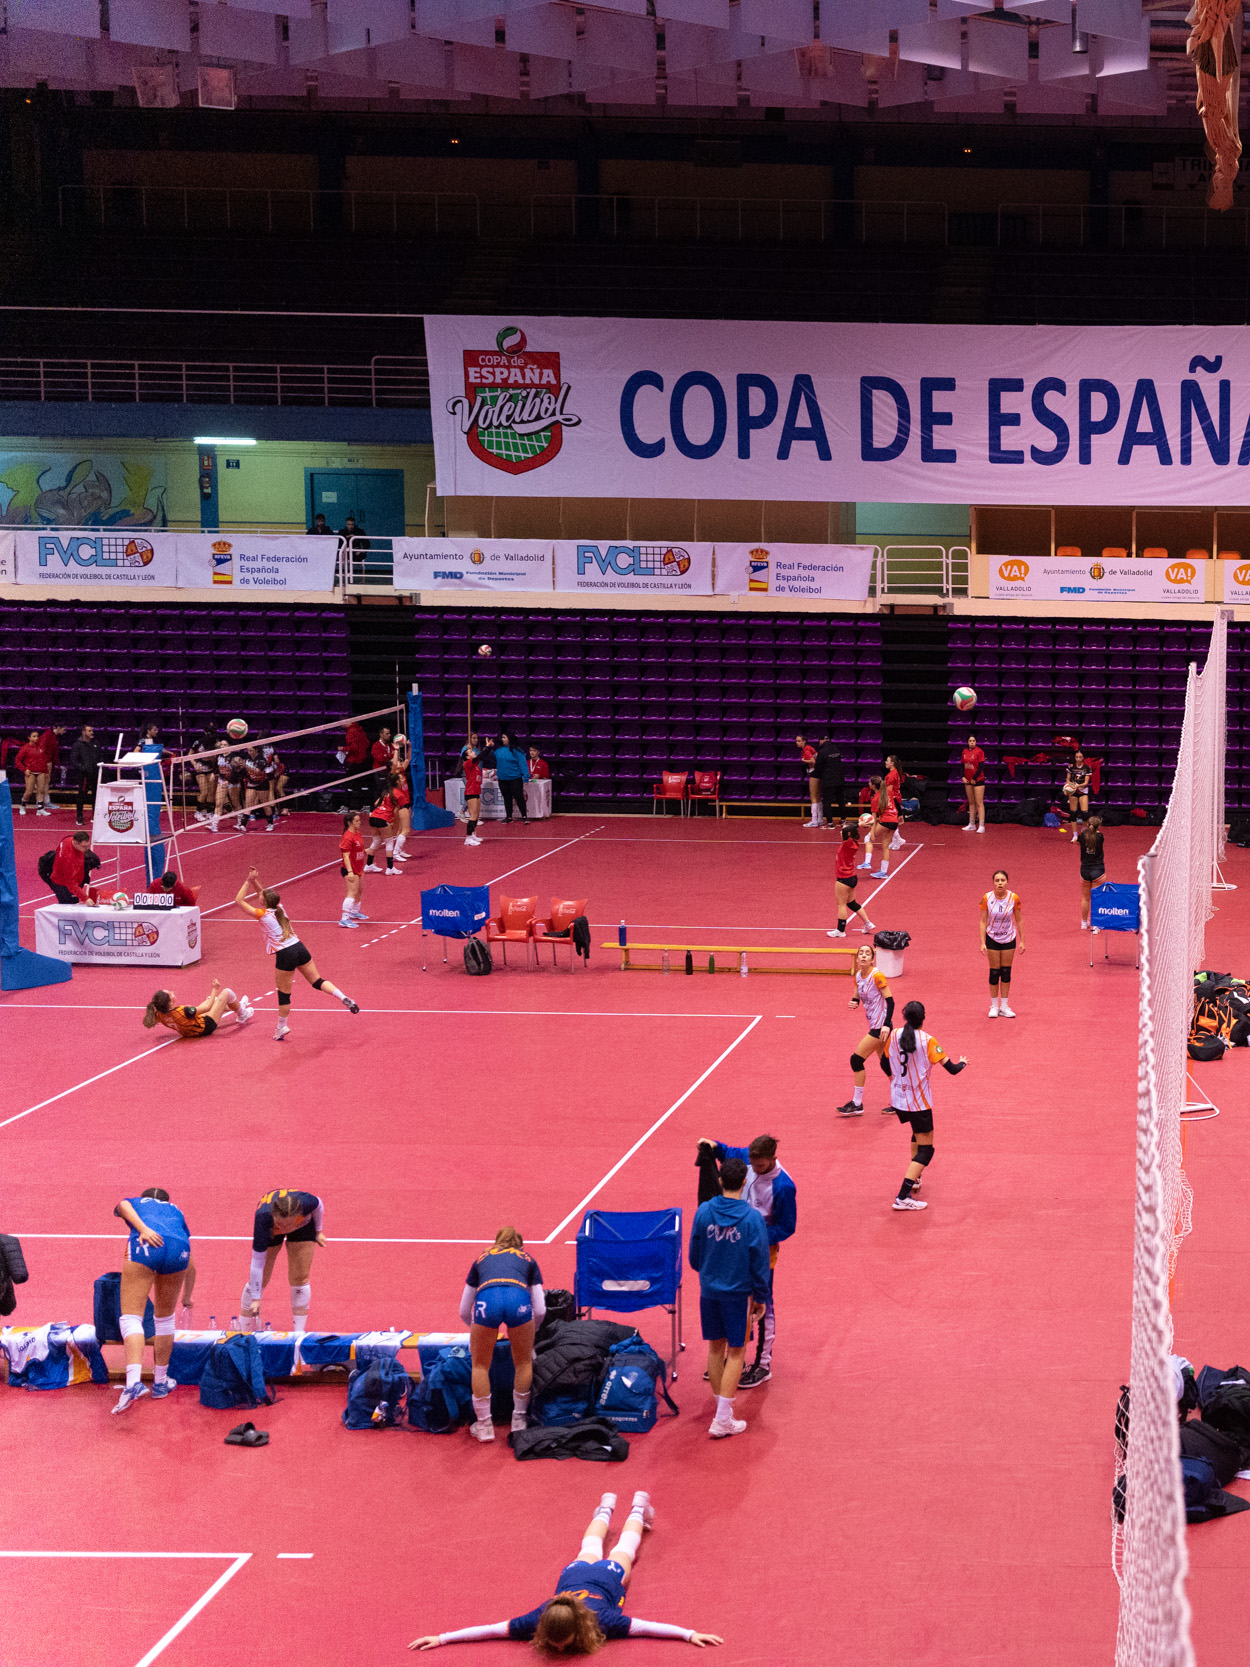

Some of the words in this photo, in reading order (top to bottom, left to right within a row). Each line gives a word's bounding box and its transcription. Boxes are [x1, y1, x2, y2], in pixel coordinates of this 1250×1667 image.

[478, 355, 508, 366] COPA
[510, 356, 525, 366] de
[467, 364, 557, 385] ESPAÑA
[446, 382, 582, 435] Voleibol
[620, 369, 832, 460] COPA
[859, 376, 957, 463] DE
[38, 536, 117, 567] FVCL
[403, 552, 464, 560] Ayuntamiento
[490, 553, 501, 561] de
[504, 553, 545, 561] Valladolid
[240, 554, 259, 562] Real
[261, 554, 309, 563] Federación
[577, 545, 654, 576] FVCL
[240, 565, 280, 575] Española
[797, 562, 844, 572] Federación
[1001, 565, 1025, 578] VA!
[39, 572, 71, 580] FEDERACIÓN
[433, 571, 464, 579] FMD
[776, 573, 815, 583] Española
[1168, 568, 1192, 580] VA!
[240, 577, 251, 585] de
[252, 577, 287, 585] Voleibol
[788, 585, 821, 593] Voleibol
[1060, 586, 1085, 594] FMD
[429, 908, 460, 918] molten
[1098, 907, 1129, 915] molten
[58, 919, 127, 946] FVCL
